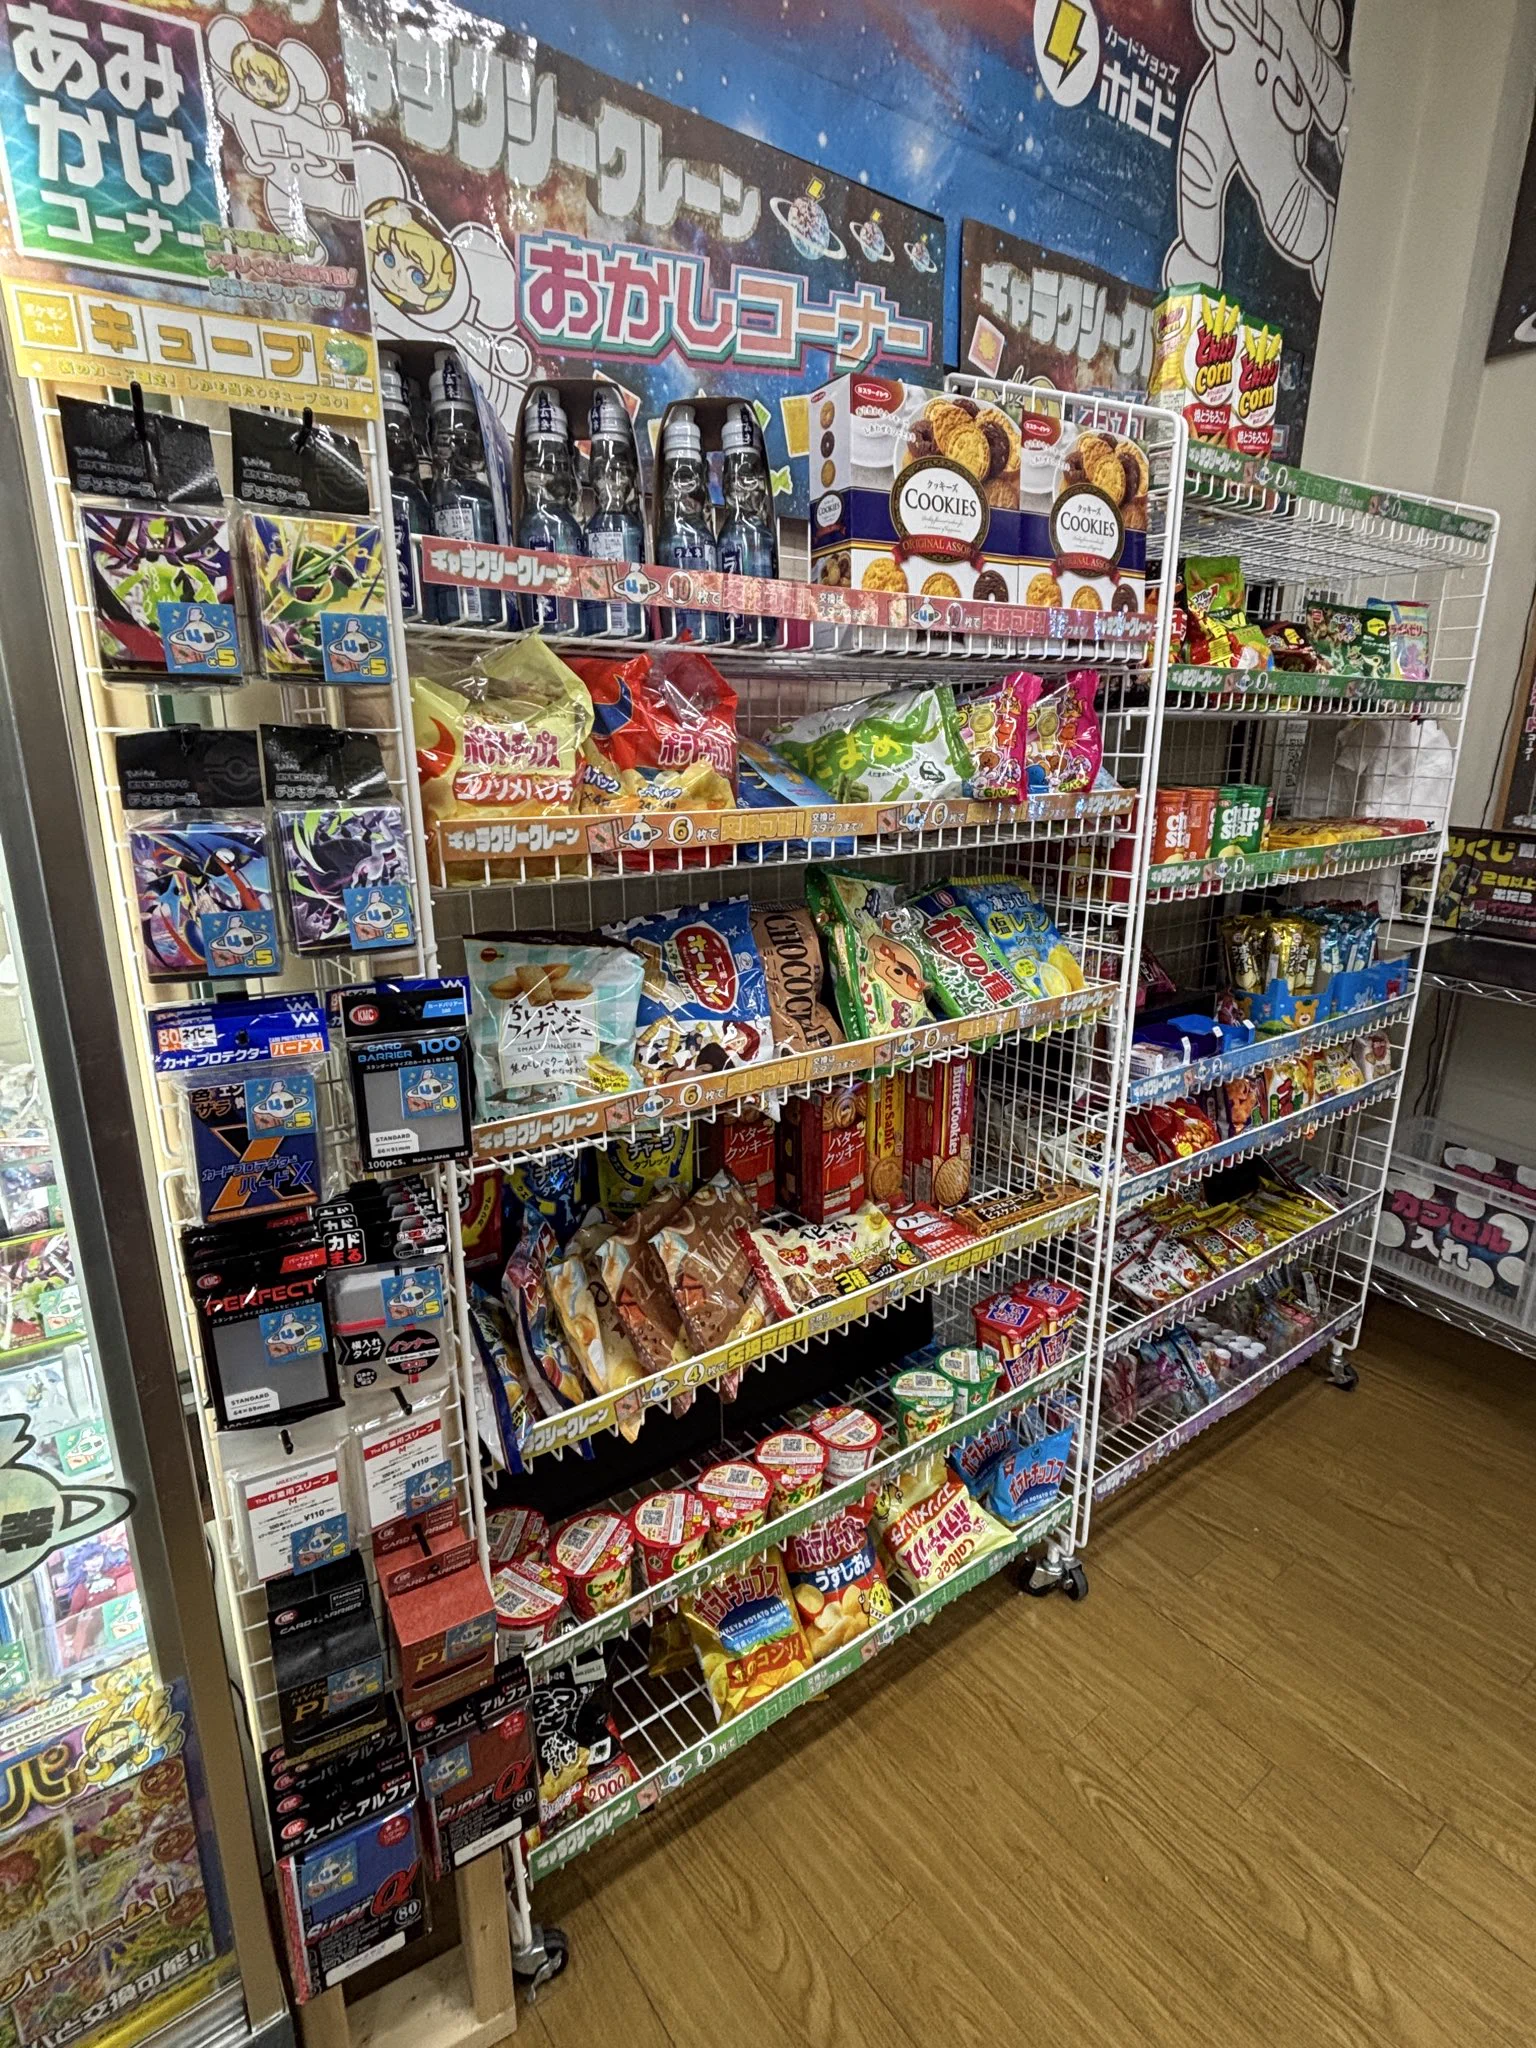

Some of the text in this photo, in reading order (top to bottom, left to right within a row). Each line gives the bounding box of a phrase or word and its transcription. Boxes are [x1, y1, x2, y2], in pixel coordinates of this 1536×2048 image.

[6, 3, 184, 117] あみ
[1104, 24, 1180, 84] カードショップ
[26, 100, 194, 206] かけ
[41, 190, 205, 255] コーナー
[524, 240, 932, 368] おかしコーナー
[89, 303, 311, 378] キューブ
[1195, 361, 1232, 395] corn
[1239, 386, 1274, 418] corn
[77, 474, 157, 498] デッキケース
[241, 481, 311, 507] デッキケース
[927, 479, 958, 493] クッキーズ
[905, 488, 977, 518] COOKIES
[1060, 512, 1115, 537] COOKIES
[902, 540, 942, 553] ORIGINAL
[669, 574, 689, 600] 10
[127, 791, 201, 806] デッキケース
[275, 785, 338, 800] デッキケース
[1222, 802, 1261, 824] chip
[673, 820, 688, 841] 6
[1220, 819, 1260, 840] star
[926, 912, 1016, 1004] 柿の種
[357, 1008, 375, 1022] KMC
[157, 1028, 179, 1047] 80
[182, 1027, 214, 1041] ネイビー
[273, 1039, 321, 1056] ハードX
[358, 1049, 413, 1063] BARRIER
[418, 1036, 461, 1056] 100
[163, 1047, 269, 1070] カードプロテクター
[683, 1085, 698, 1105] 6
[375, 1133, 411, 1144] STANDARD
[731, 1125, 773, 1145] バター
[828, 1127, 864, 1150] バター
[725, 1137, 774, 1162] クッキー
[824, 1142, 865, 1168] クッキー
[202, 1154, 298, 1182] カードプロテクター
[368, 1158, 407, 1171] 100pcs.
[238, 1160, 313, 1196] ハードX
[1391, 1188, 1513, 1255] カプセル
[328, 1232, 362, 1252] カド
[1411, 1224, 1471, 1271] 入れ
[329, 1245, 363, 1266] まる
[834, 1267, 870, 1293] 3種
[206, 1279, 316, 1317] PERFECT
[352, 1346, 382, 1360] タイプ
[689, 1364, 700, 1382] 4
[230, 1391, 270, 1407] STANDARD
[411, 1455, 431, 1470] ¥110
[1008, 1457, 1065, 1503] ポテトチップス
[304, 1508, 325, 1522] ¥110
[694, 1564, 783, 1627] ポテトチップス
[279, 1620, 312, 1636] CARD
[514, 1791, 533, 1808] 80
[588, 1773, 627, 1804] 2000
[303, 1784, 411, 1843] スーパーアルファ
[398, 1901, 418, 1923] 80
